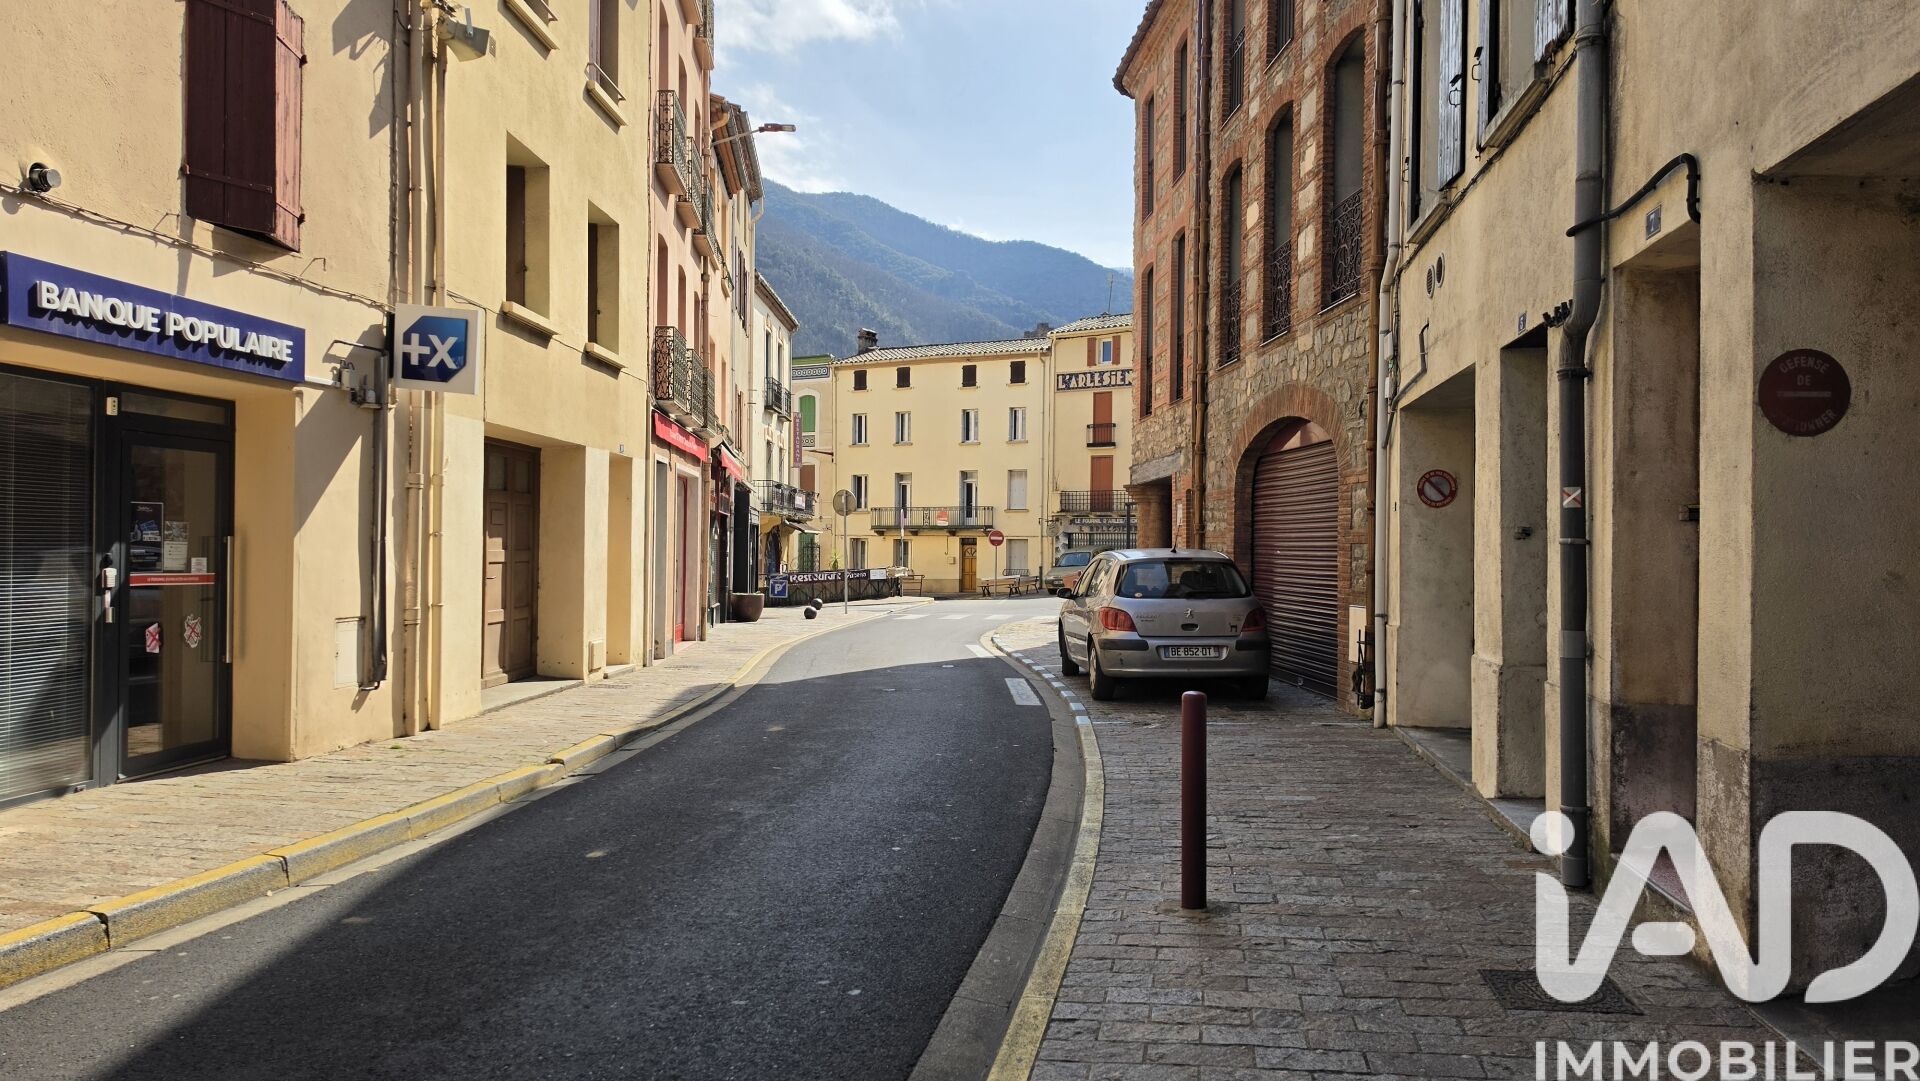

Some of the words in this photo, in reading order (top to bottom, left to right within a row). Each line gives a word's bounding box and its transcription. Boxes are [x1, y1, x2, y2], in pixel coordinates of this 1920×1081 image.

[36, 280, 161, 333] BANQUE
[165, 311, 294, 363] POPULAIRE
[1779, 356, 1830, 374] DEFENSE
[1796, 374, 1812, 386] DE
